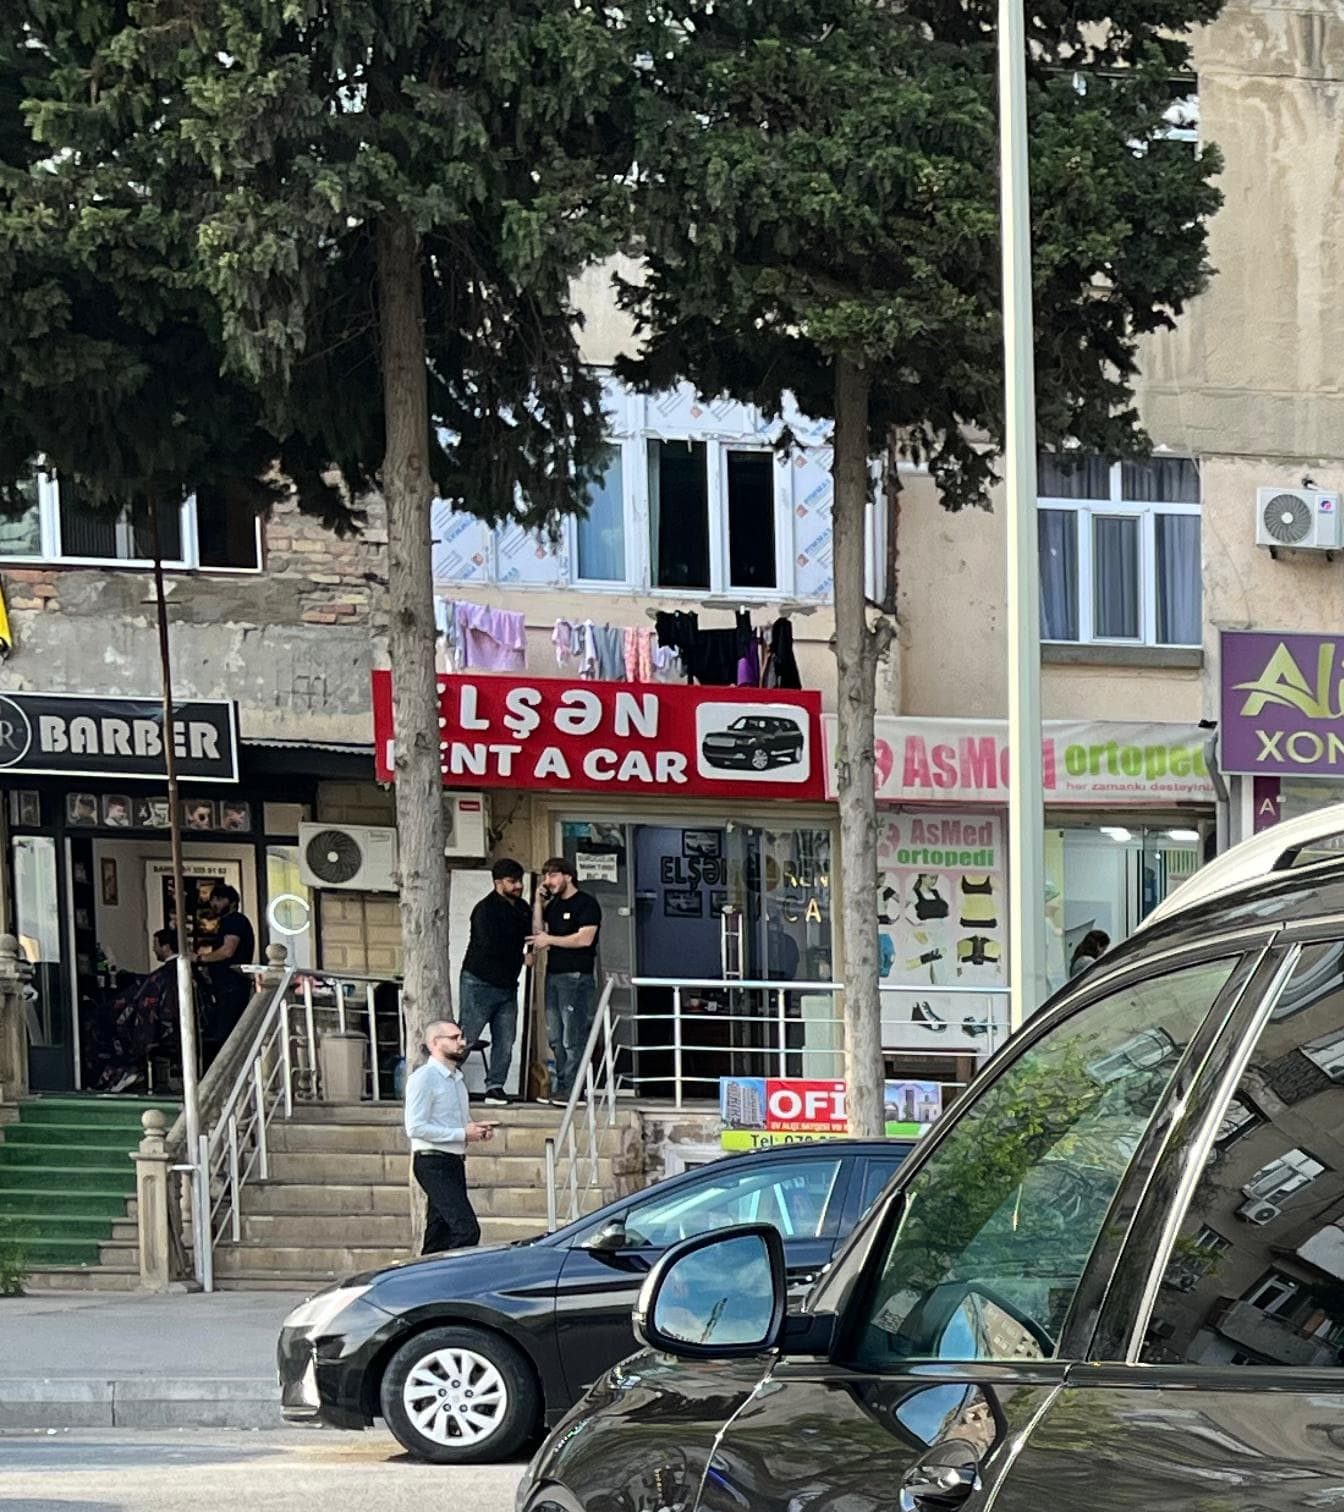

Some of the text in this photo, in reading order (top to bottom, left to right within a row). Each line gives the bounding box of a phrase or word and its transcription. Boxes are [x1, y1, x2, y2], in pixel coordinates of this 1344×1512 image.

[39, 715, 222, 759] BARBER
[533, 746, 571, 780] A
[582, 748, 688, 784] CAR
[911, 819, 993, 846] AsMed
[897, 848, 994, 868] ortopedi
[768, 1084, 847, 1119] OFİ
